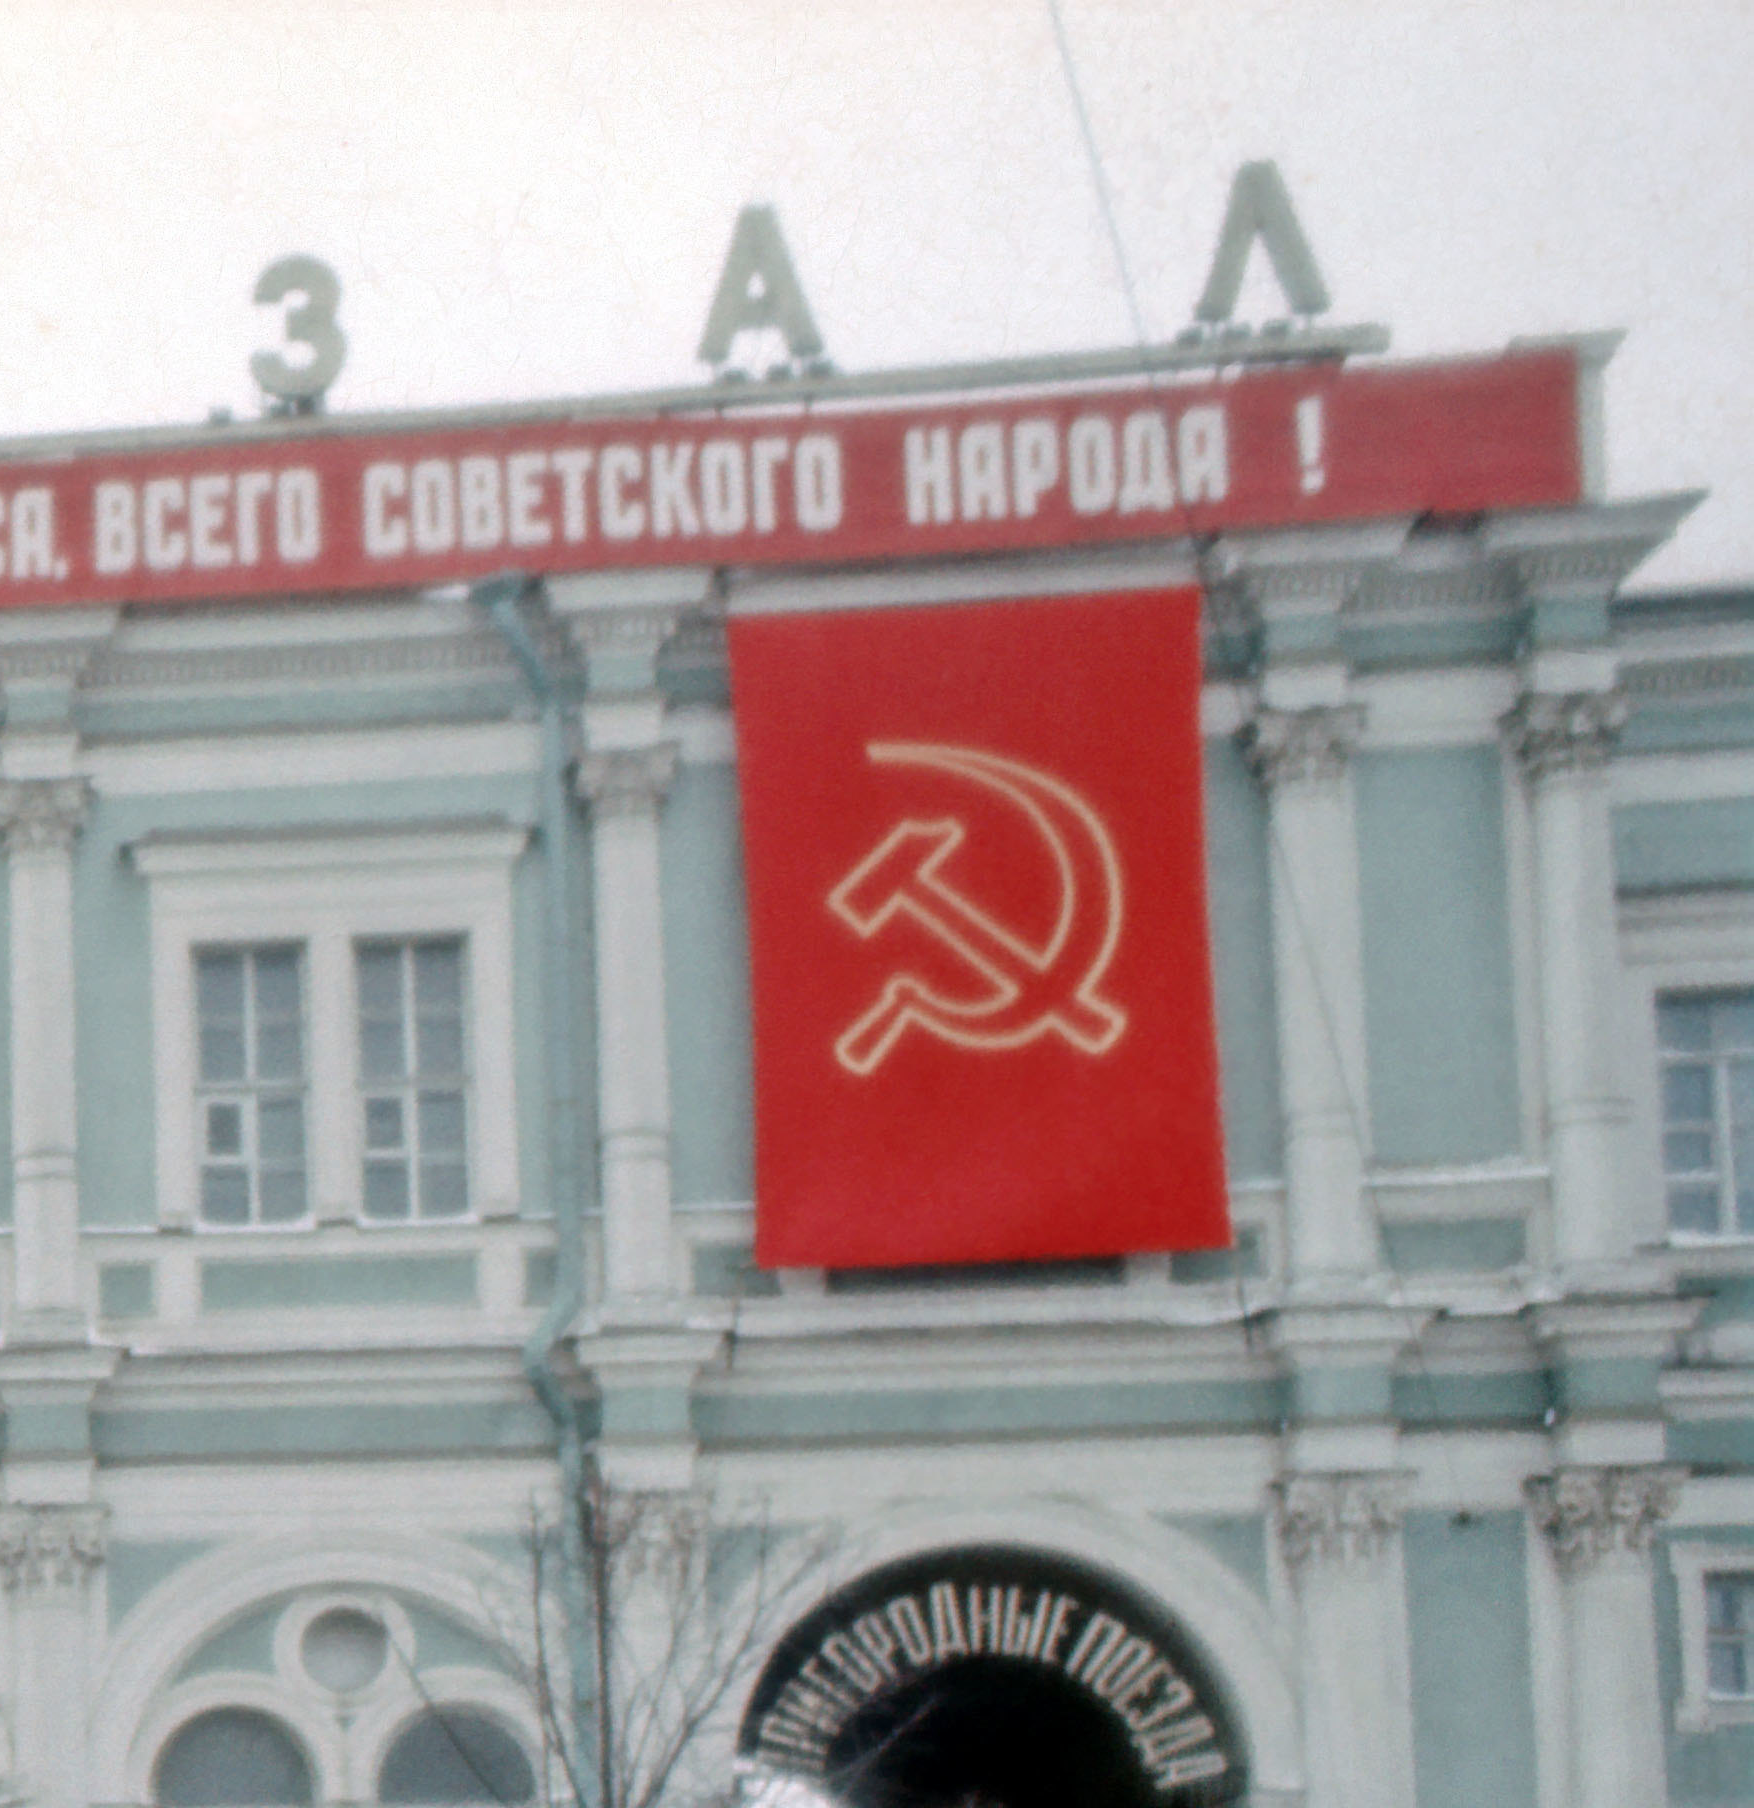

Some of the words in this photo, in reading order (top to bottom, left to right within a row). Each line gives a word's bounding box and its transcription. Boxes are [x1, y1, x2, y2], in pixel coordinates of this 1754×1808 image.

[95, 467, 320, 576] ВСЕГО
[361, 433, 844, 559] СОВЕТСКОГО
[903, 404, 1228, 527] НАРОДА
[1065, 1608, 1229, 1791] ПОЕЗДА
